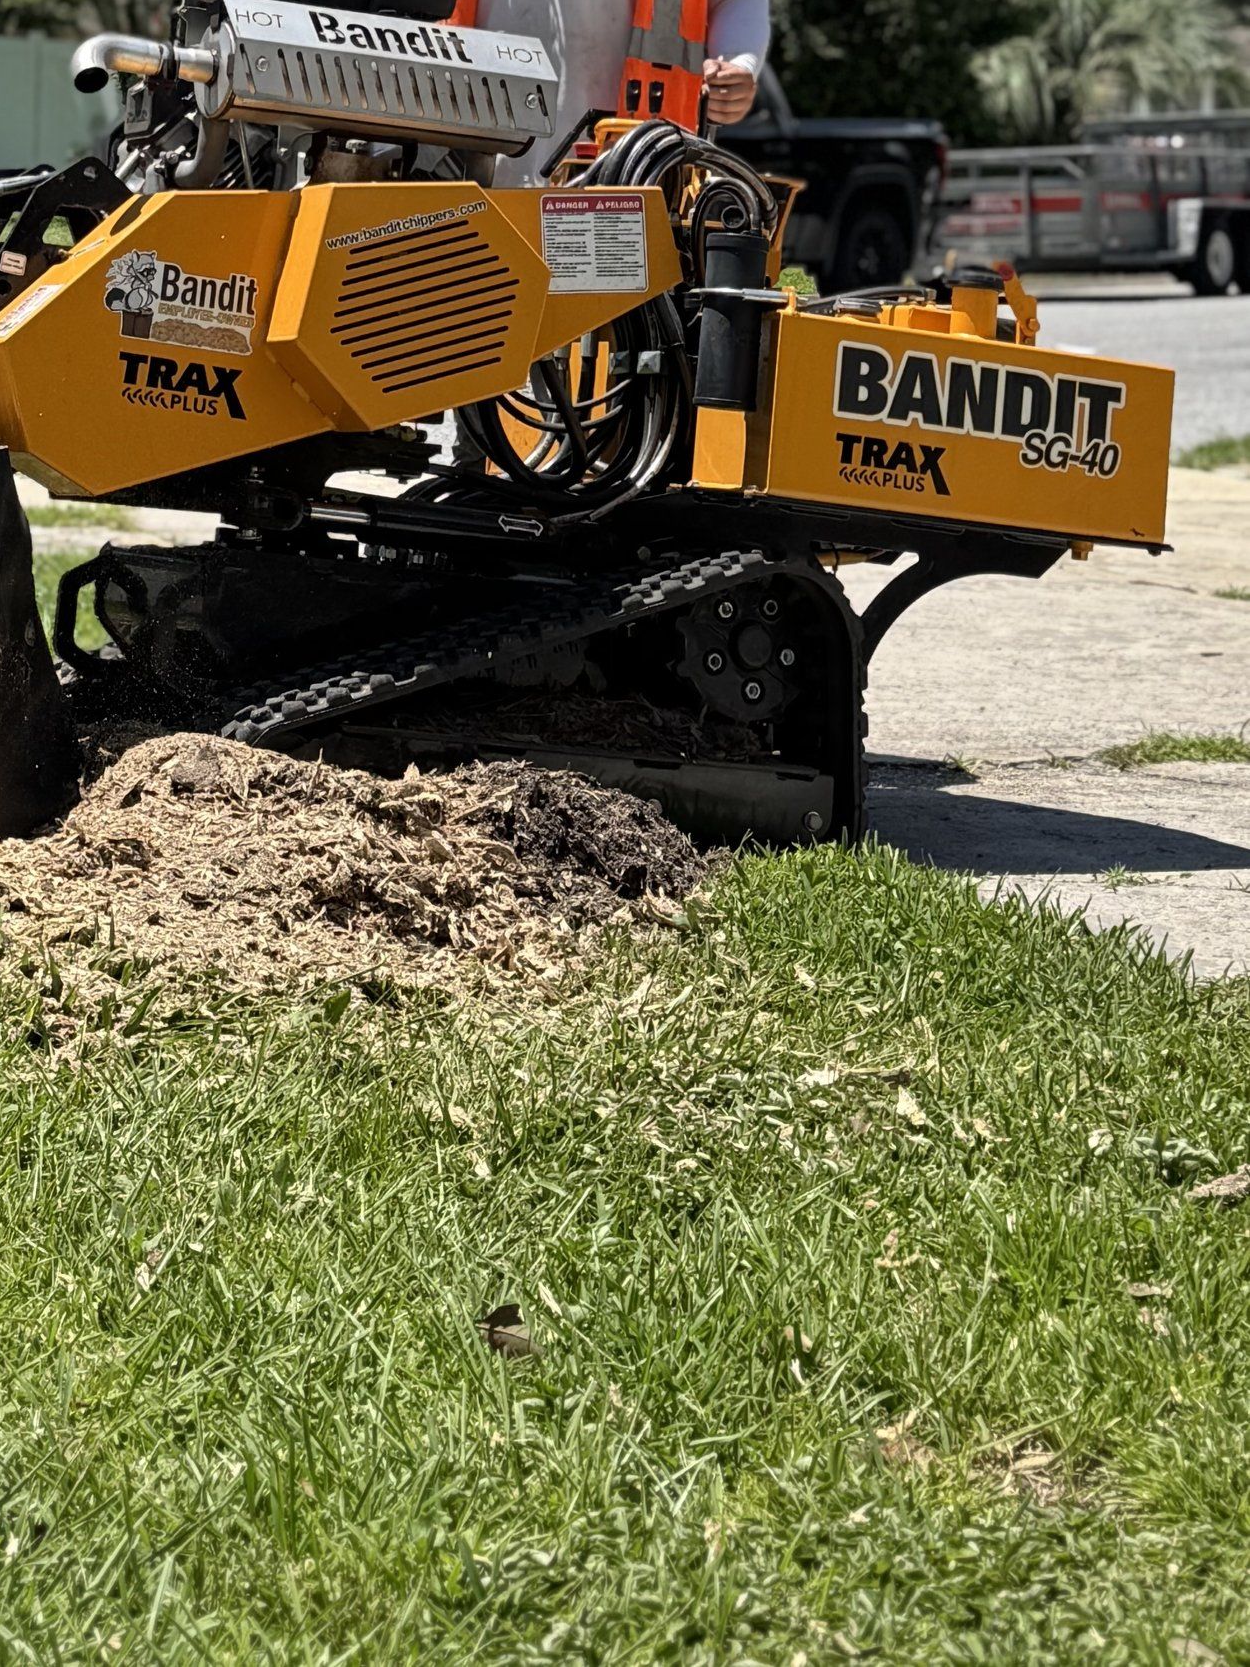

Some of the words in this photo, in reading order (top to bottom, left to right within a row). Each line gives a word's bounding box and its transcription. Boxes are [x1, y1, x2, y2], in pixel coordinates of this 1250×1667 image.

[234, 8, 284, 28] HOT
[309, 10, 473, 64] Bandit
[497, 45, 543, 66] HOT
[326, 200, 487, 249] www.banditchippers.com
[555, 201, 589, 209] DANGER
[161, 264, 258, 315] Bandit
[119, 351, 247, 421] TRAX
[170, 393, 219, 416] PLUS
[836, 345, 1123, 442] BANDIT
[836, 432, 951, 496] TRAX
[1020, 433, 1120, 477] SG-40
[883, 472, 925, 492] PLUS
